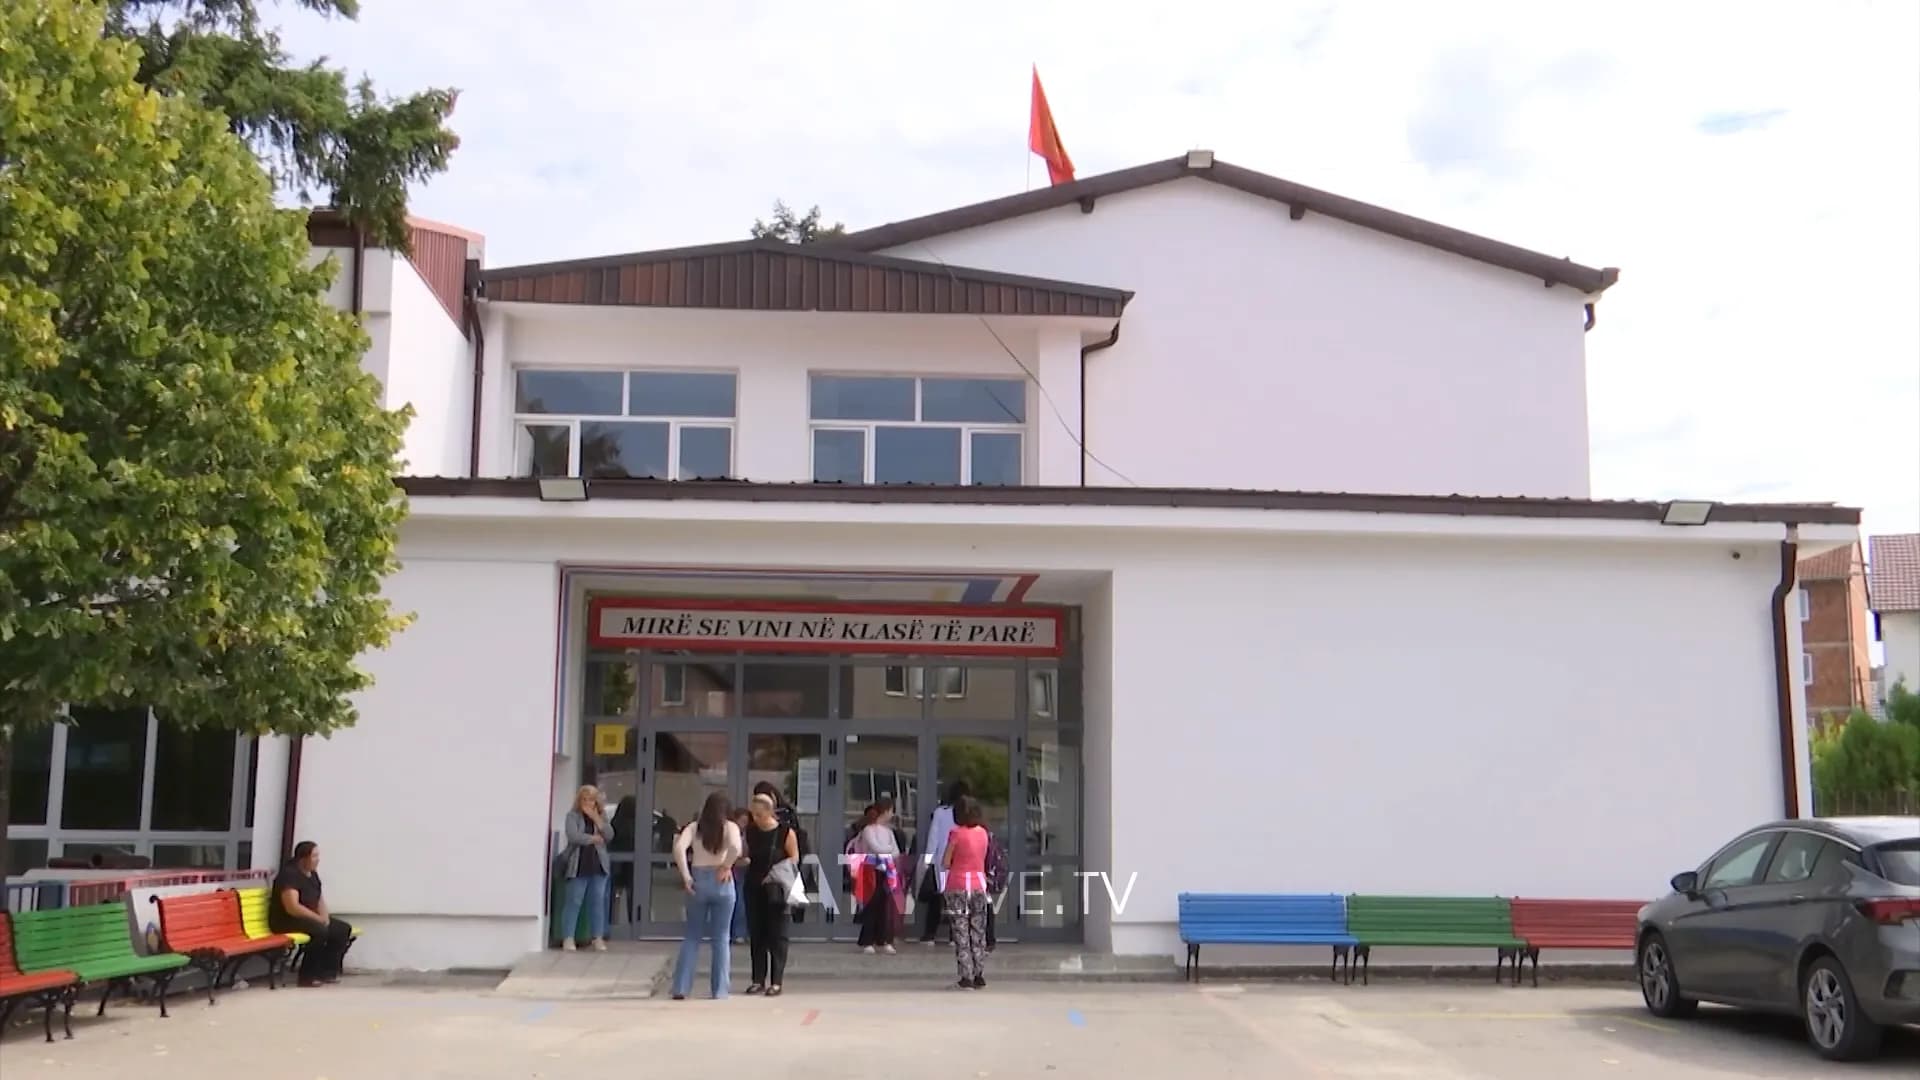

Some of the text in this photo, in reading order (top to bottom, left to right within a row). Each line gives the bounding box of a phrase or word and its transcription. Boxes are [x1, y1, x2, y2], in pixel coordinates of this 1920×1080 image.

[622, 613, 1036, 644] MIRË SE VINI NË KLASË TË PARË
